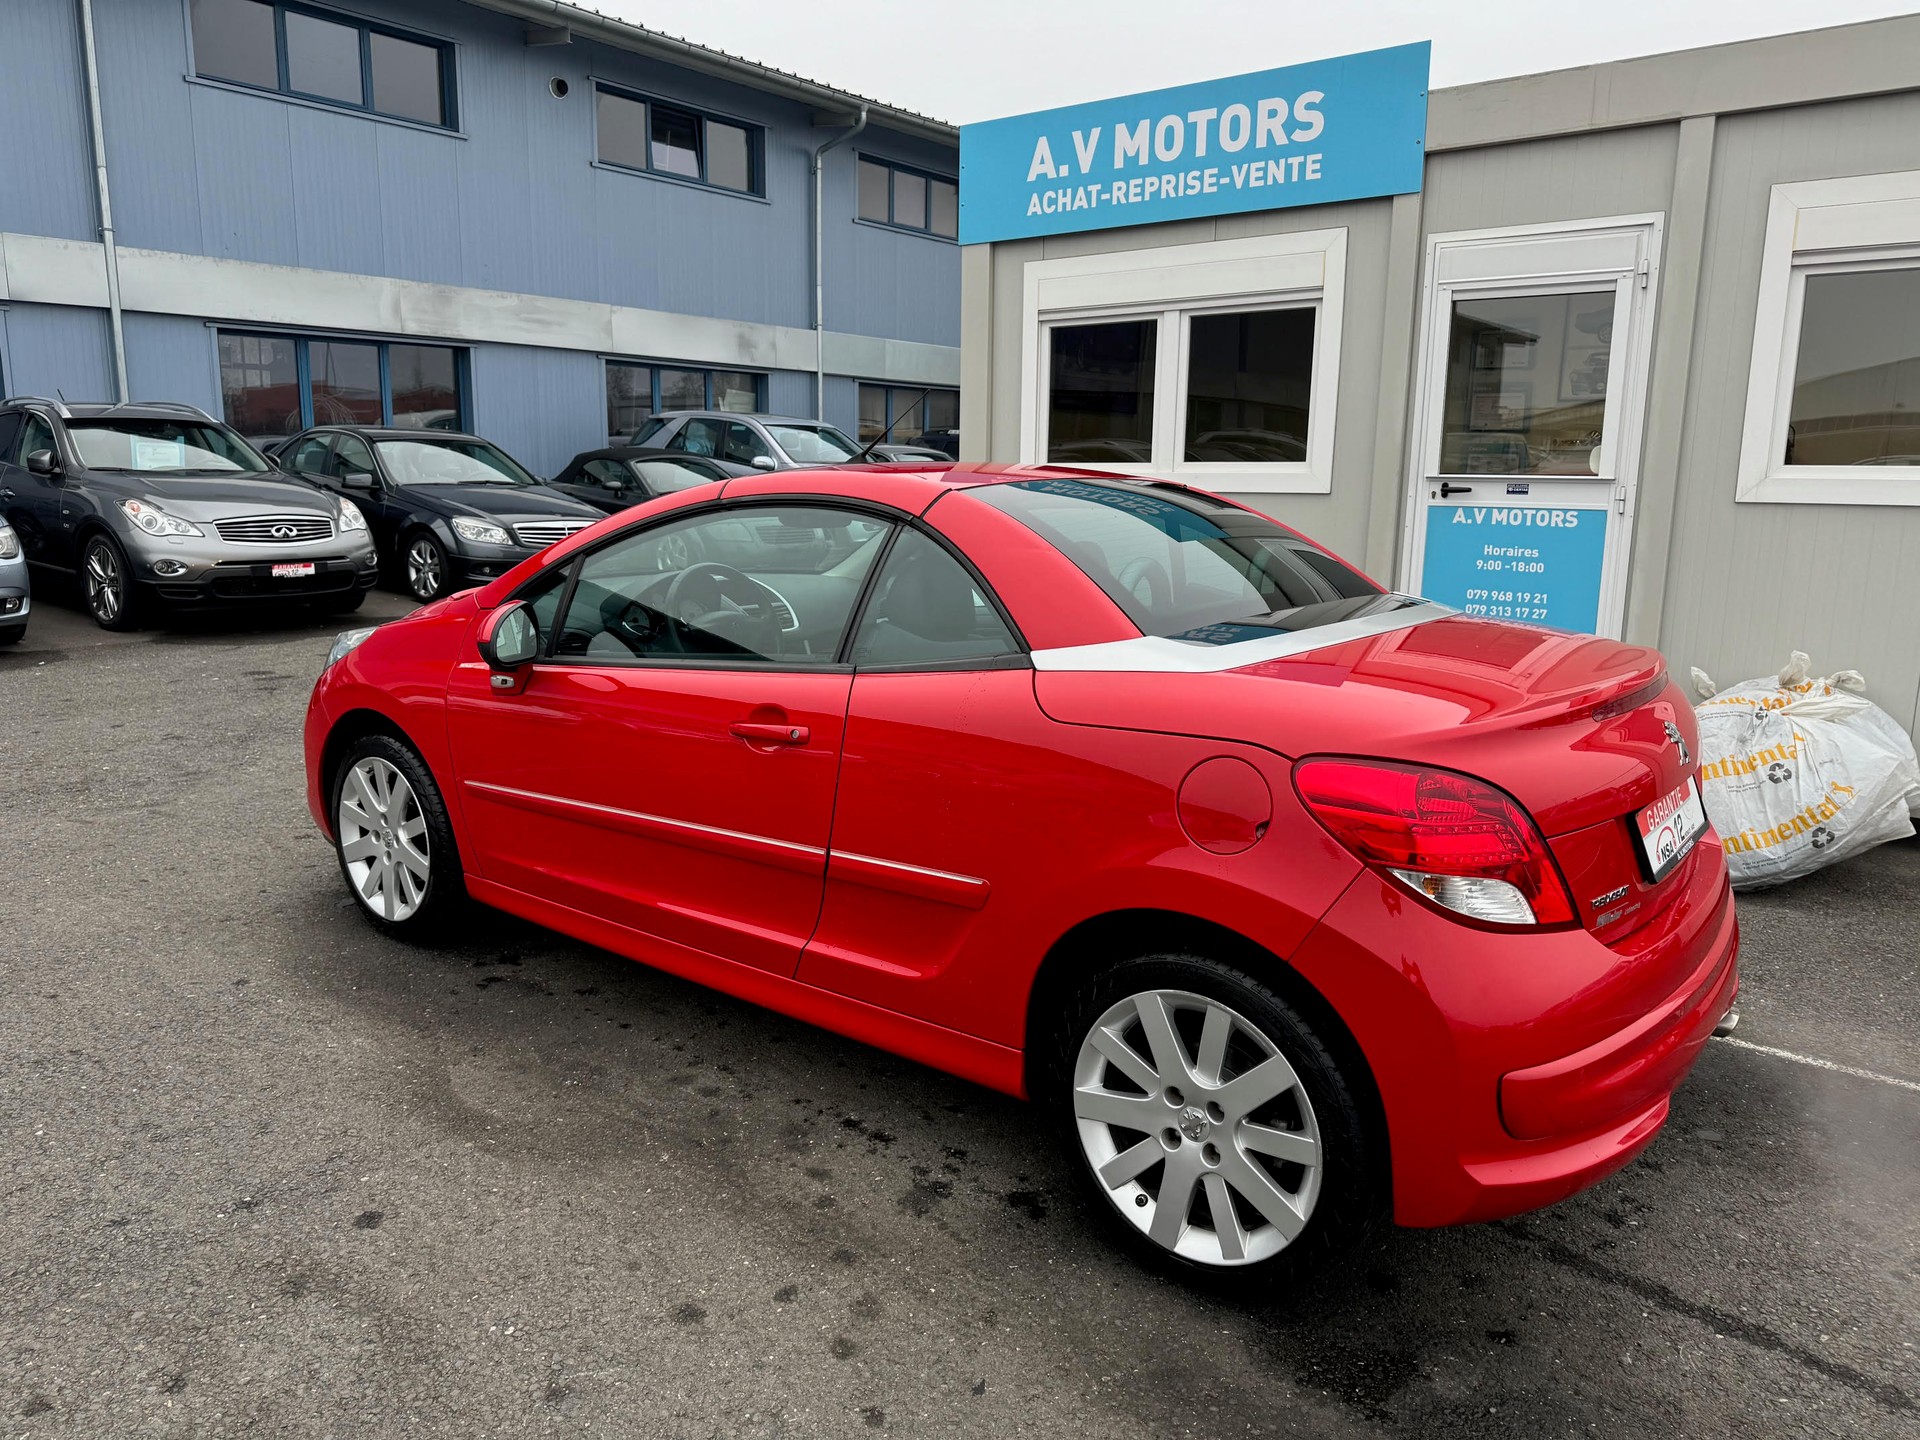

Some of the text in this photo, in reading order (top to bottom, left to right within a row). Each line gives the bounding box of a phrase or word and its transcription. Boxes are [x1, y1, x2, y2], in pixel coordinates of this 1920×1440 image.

[1026, 90, 1325, 182] A.V MOTORS
[1026, 153, 1323, 216] ACHAT-REPRISE-VENTE
[1452, 507, 1578, 527] A.V MOTORS
[1484, 545, 1539, 557] Horaires
[1476, 560, 1502, 571] 9:00
[1466, 589, 1547, 604] 079 968 19 21
[1465, 604, 1547, 619] 079 313 17 27
[1646, 786, 1684, 831] GARANTIE
[1673, 813, 1685, 844] 12
[1722, 793, 1841, 855] ntinental
[1660, 840, 1675, 862] NSA
